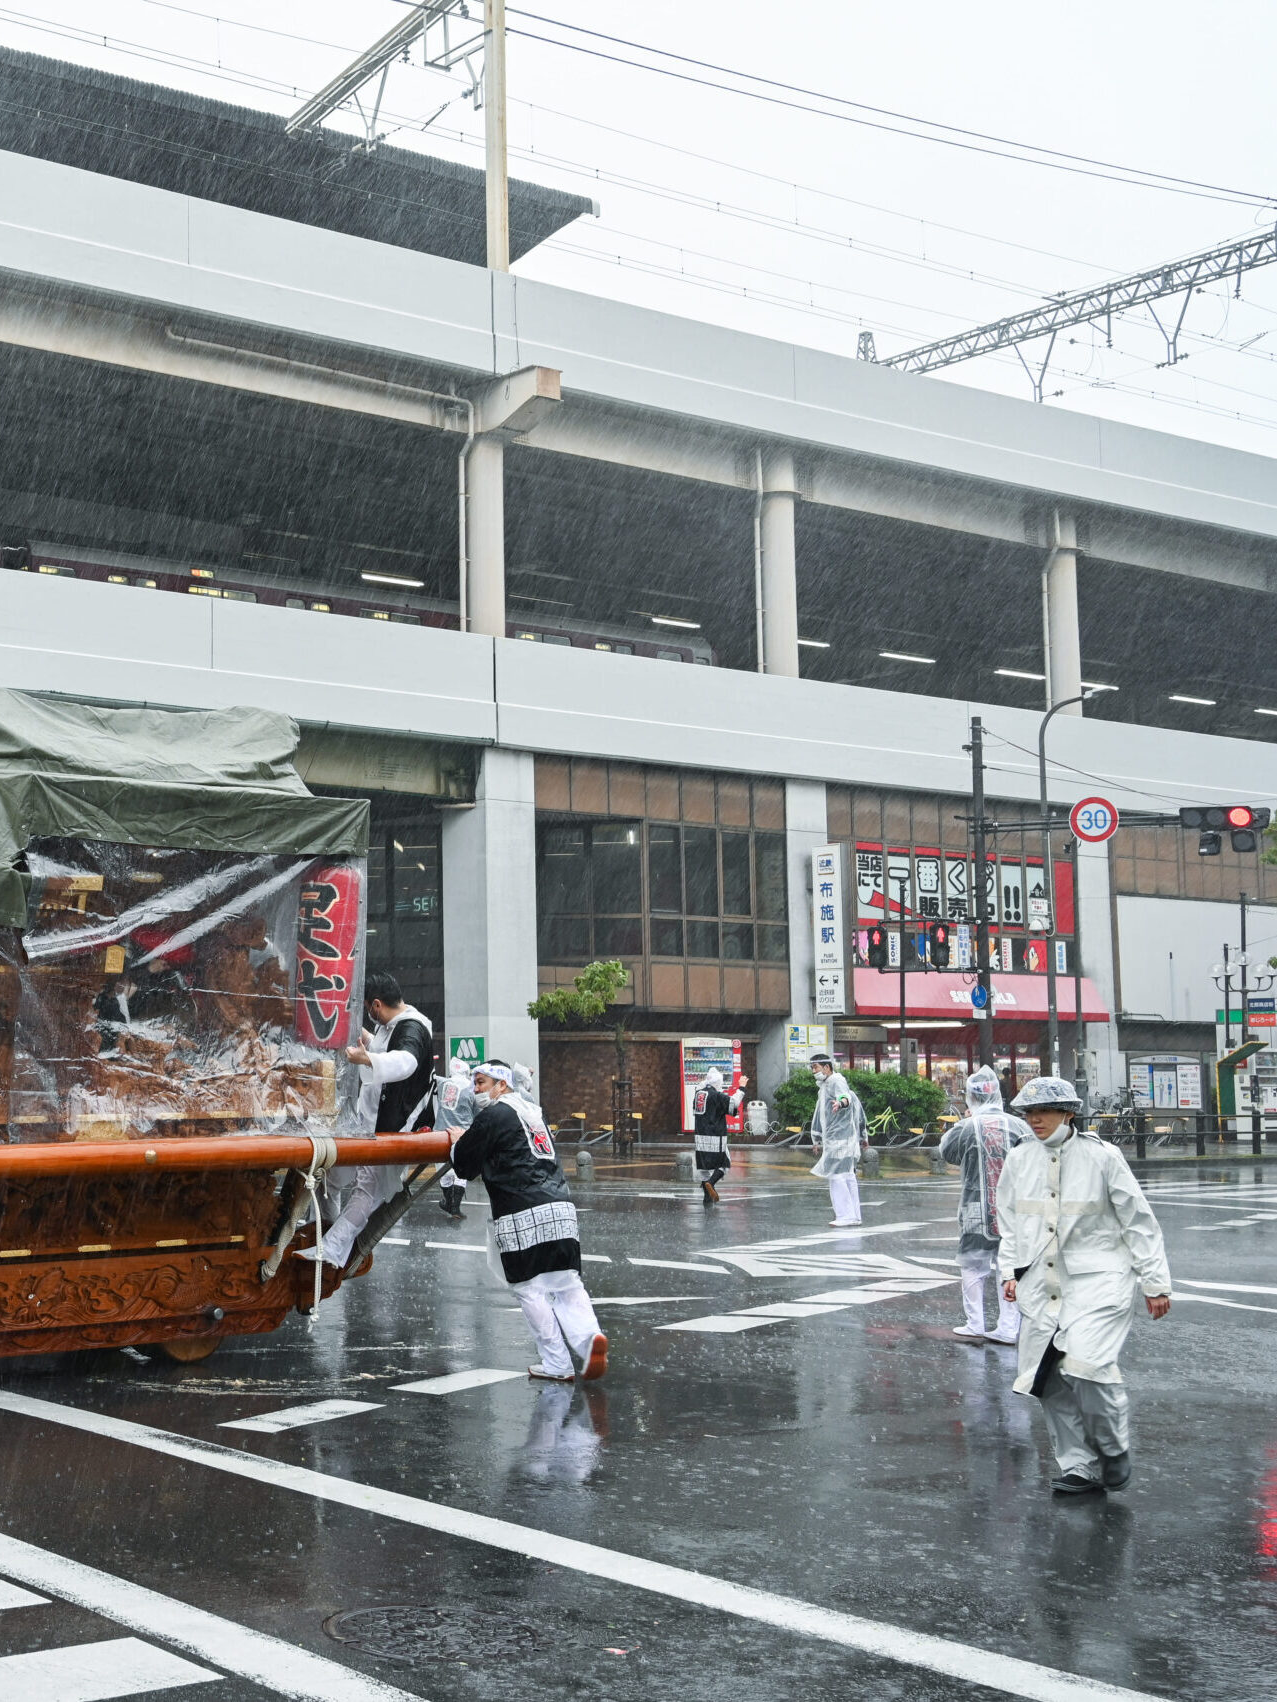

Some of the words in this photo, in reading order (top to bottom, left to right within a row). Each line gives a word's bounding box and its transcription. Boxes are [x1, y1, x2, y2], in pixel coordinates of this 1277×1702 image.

[1081, 809, 1108, 830] 30
[858, 855, 882, 871] 当店
[858, 871, 882, 888] にて
[819, 881, 835, 944] 布施駅
